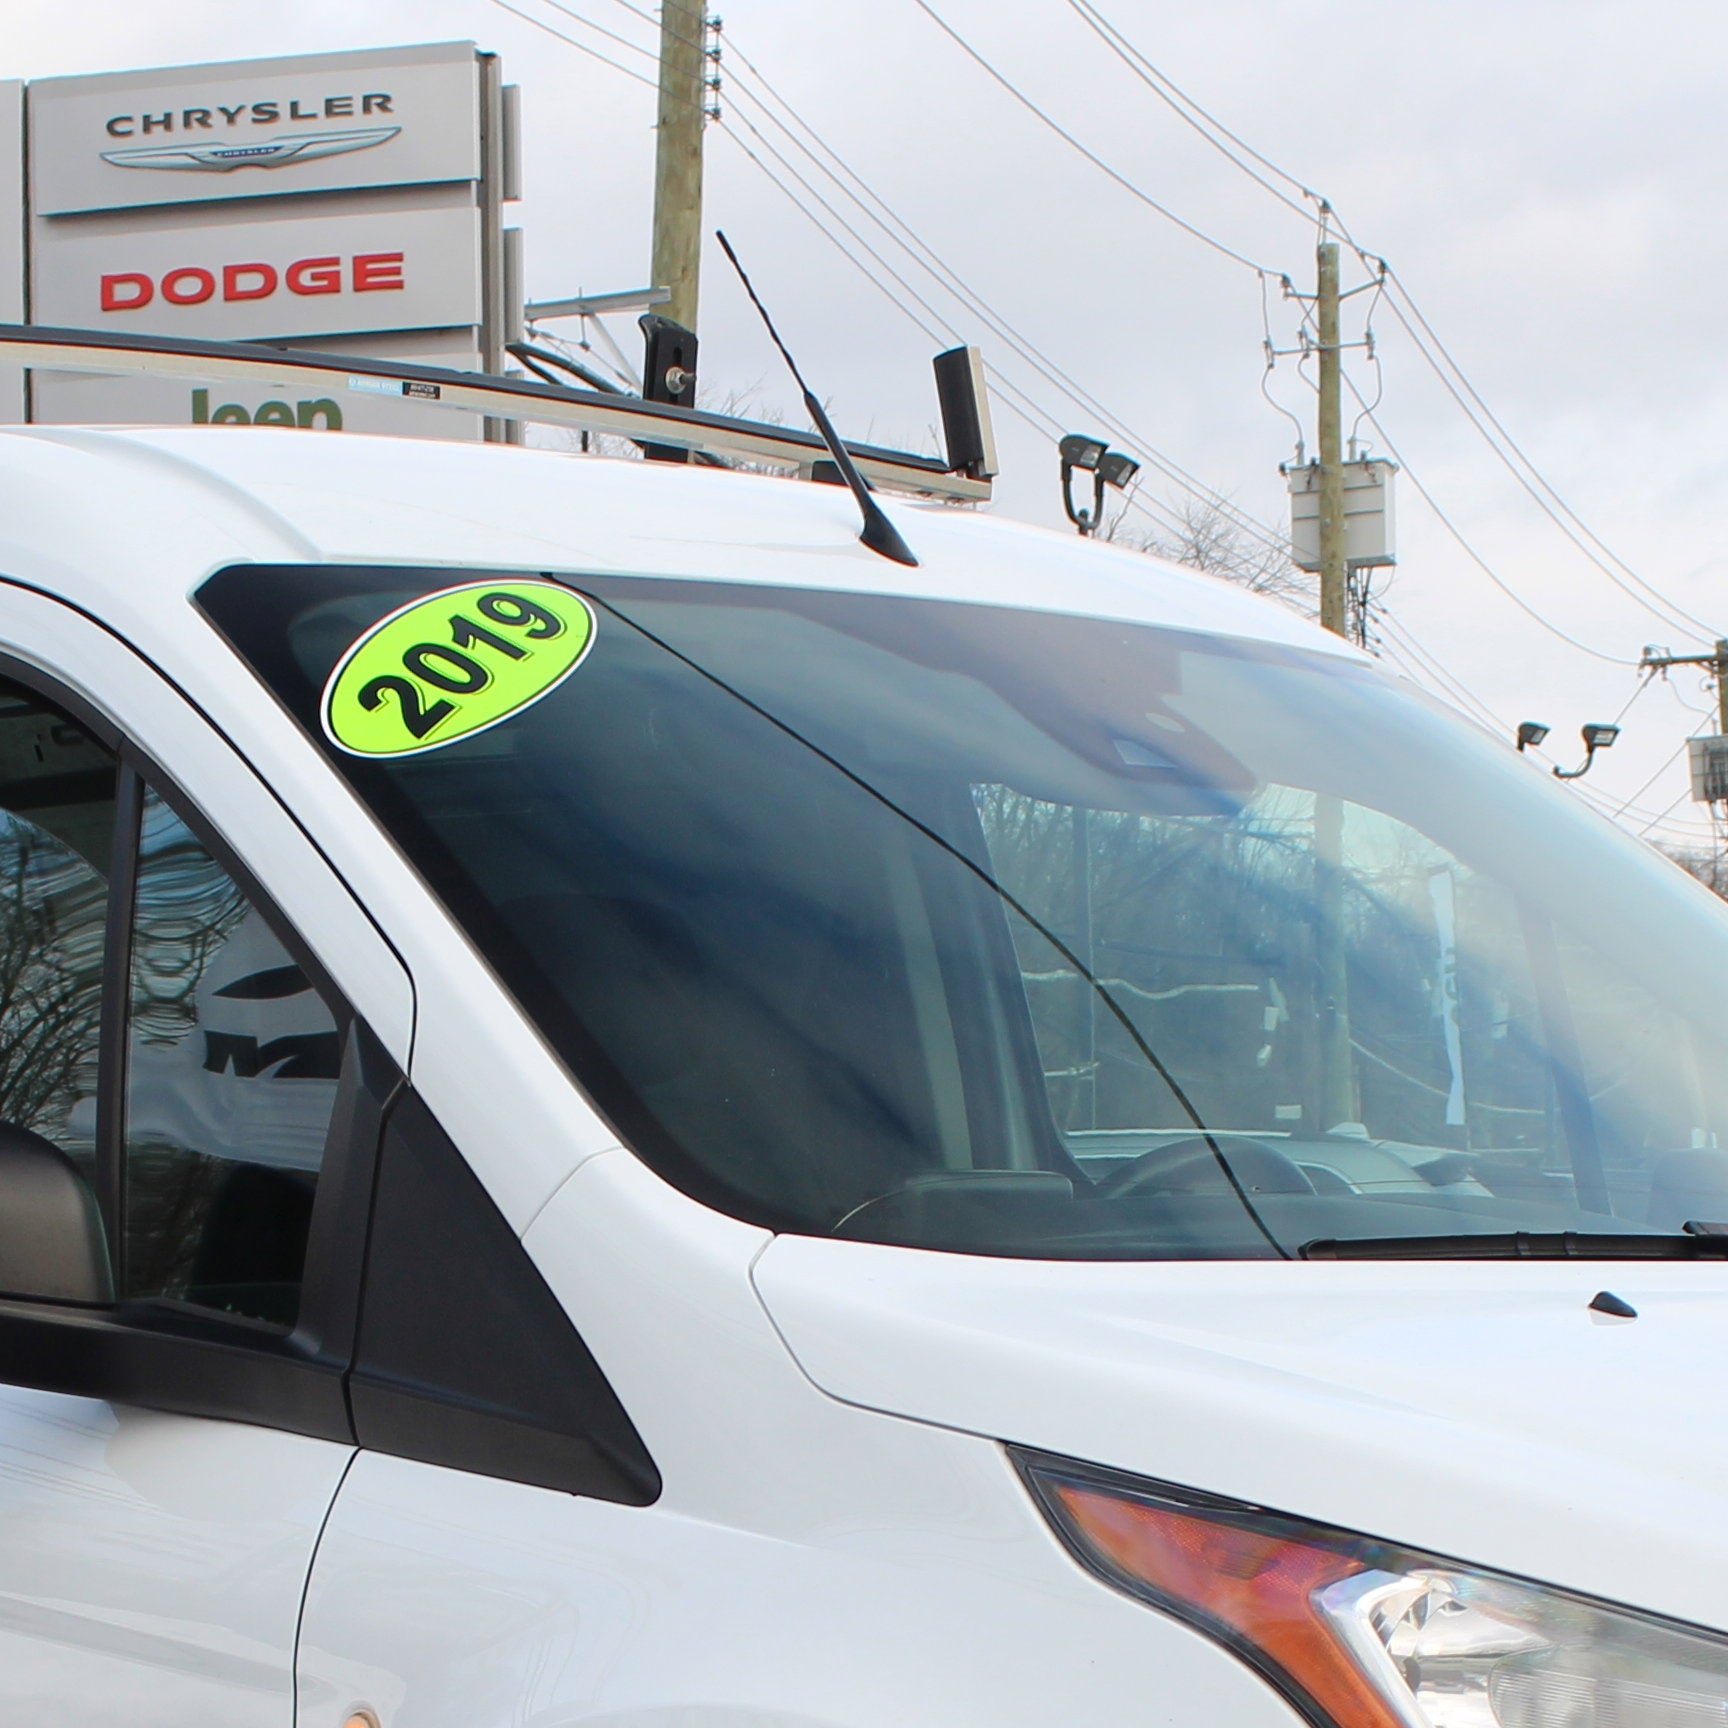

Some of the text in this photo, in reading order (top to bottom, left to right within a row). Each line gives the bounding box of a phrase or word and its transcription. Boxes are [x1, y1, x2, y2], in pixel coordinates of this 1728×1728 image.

[105, 92, 394, 137] CHRYSLER
[100, 252, 405, 312] DODGE
[358, 592, 568, 740] 2019
